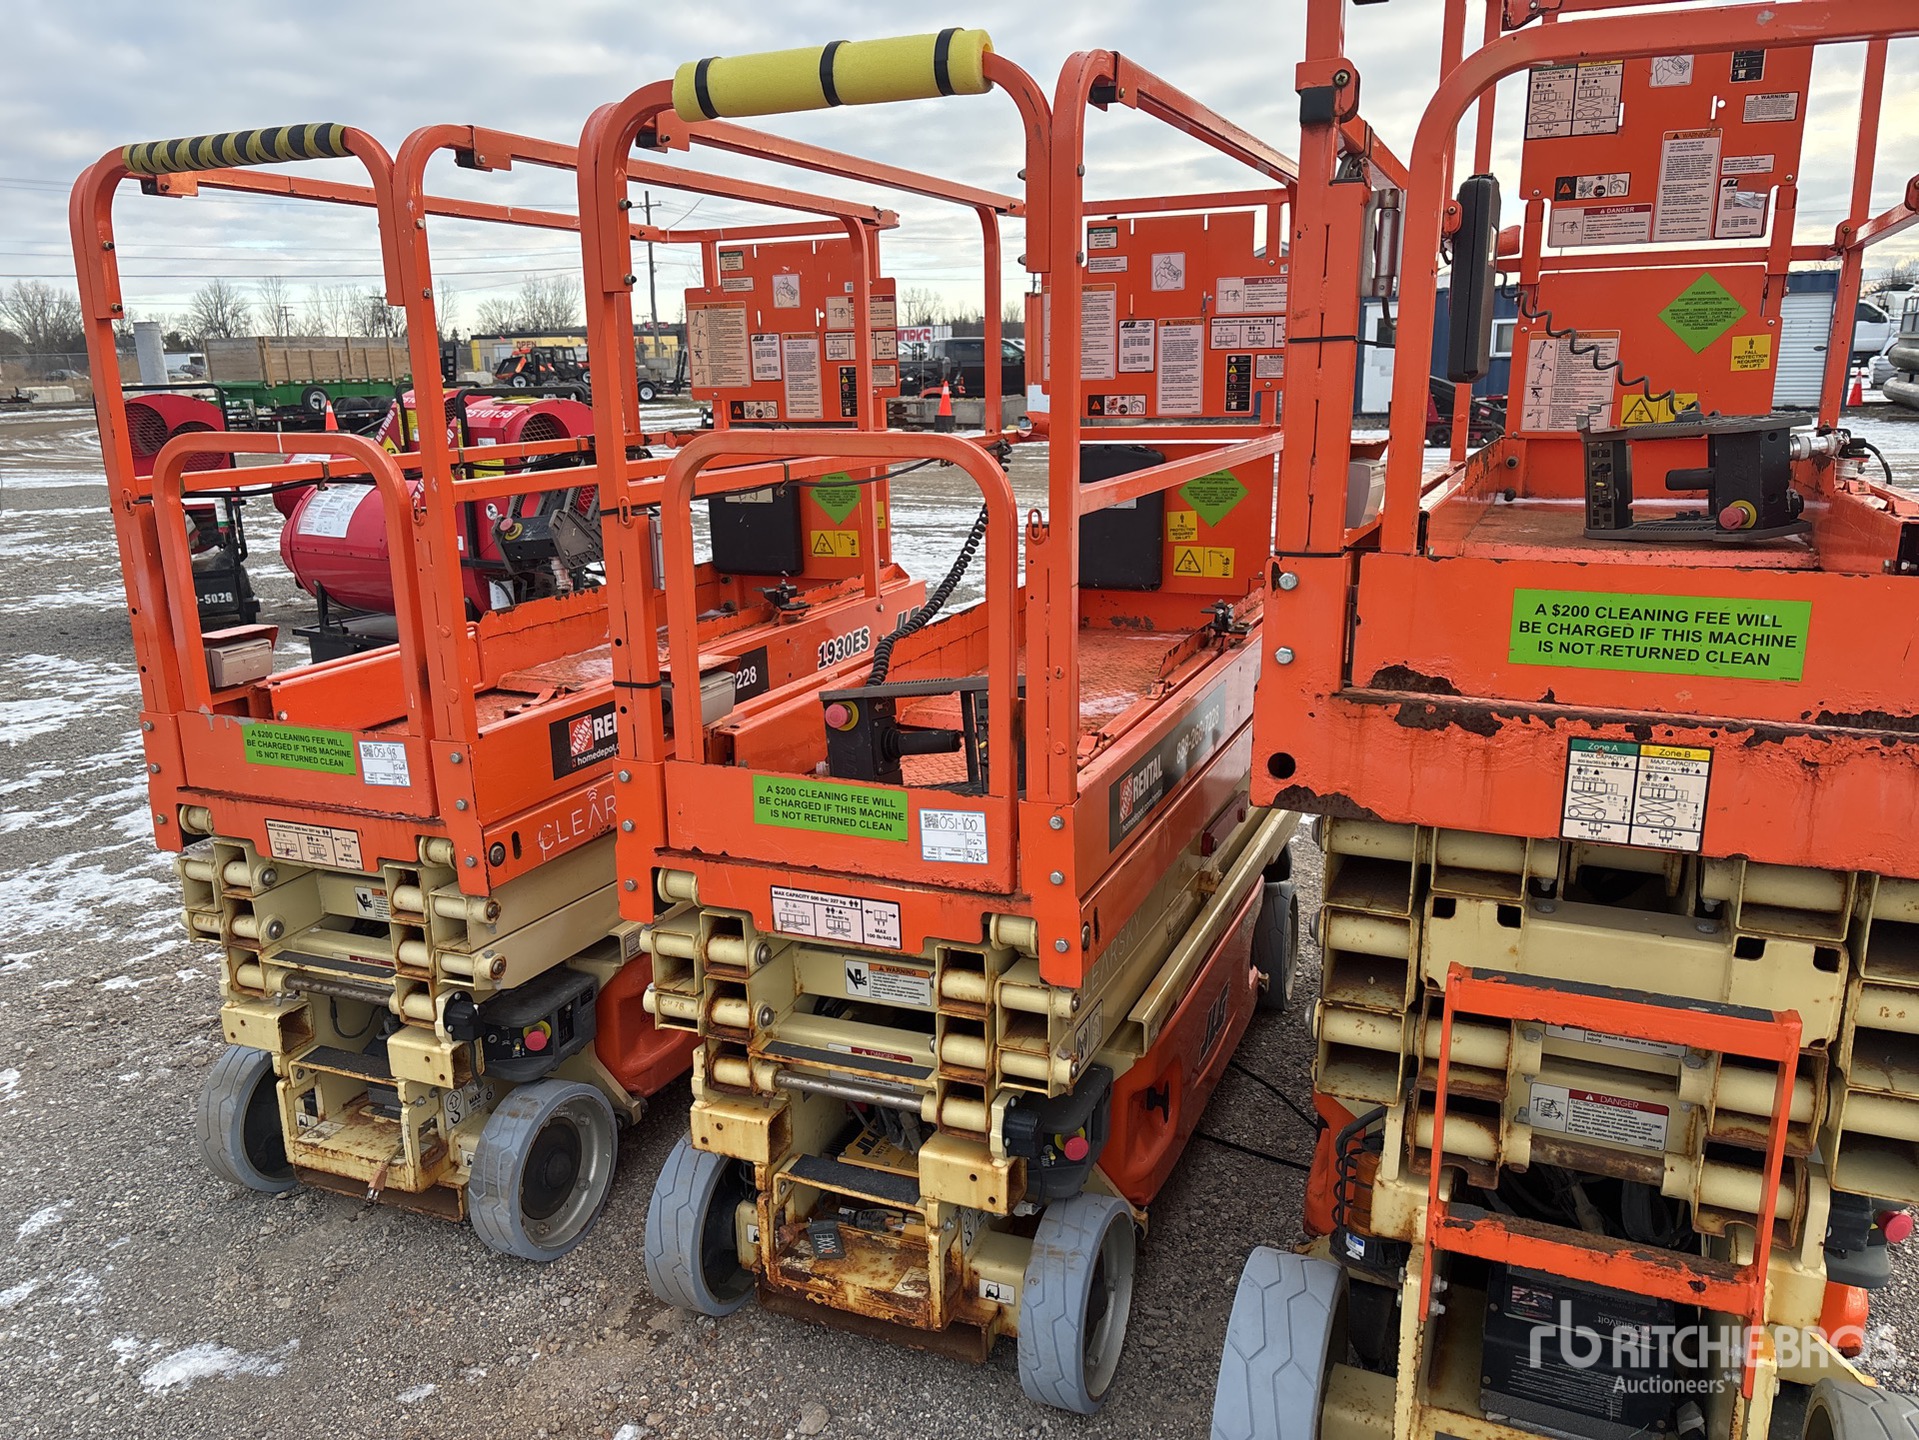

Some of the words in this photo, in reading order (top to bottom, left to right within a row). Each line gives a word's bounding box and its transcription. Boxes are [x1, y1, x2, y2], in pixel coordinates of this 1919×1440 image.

[516, 340, 537, 349] OPEN
[1535, 604, 1547, 616] A
[1552, 604, 1590, 618] $200
[1595, 607, 1689, 623] CLEANING
[1695, 612, 1731, 625] FEE
[1737, 614, 1782, 628] WILL
[1519, 621, 1542, 634] BE
[1547, 623, 1634, 639] CHARGED
[1640, 628, 1656, 640] IF
[1662, 629, 1702, 642] THIS
[1709, 632, 1797, 648] MACHINE
[818, 627, 869, 668] 1930ES
[1538, 641, 1553, 653] IS
[1559, 642, 1595, 655] NOT
[1600, 644, 1700, 661] RETURNED
[1706, 651, 1770, 666] CLEAN
[736, 666, 757, 689] 228
[258, 731, 273, 739] $200
[275, 732, 310, 743] CLEANING
[327, 738, 344, 747] WILL
[571, 716, 592, 754] HOME
[573, 723, 581, 737] THE
[258, 740, 292, 751] CHARGED
[302, 746, 317, 754] THIS
[320, 748, 351, 758] MACHINE
[581, 729, 593, 751] DEPOT
[1588, 743, 1610, 751] Zone
[256, 750, 263, 758] IS
[265, 751, 279, 759] NOT
[281, 754, 318, 764] RETURNED
[321, 758, 344, 767] CLEAN
[1659, 749, 1682, 757] Zone
[1133, 754, 1163, 803] RENTAL
[767, 785, 774, 793] A
[776, 786, 796, 796] $200
[799, 789, 848, 802] CLEANING
[851, 795, 869, 804] FEE
[872, 797, 896, 808] WILL
[759, 796, 771, 805] BE
[774, 798, 821, 811] CHARGED
[824, 804, 832, 812] IF
[835, 805, 857, 815] THIS
[860, 808, 904, 821] MACHINE
[782, 811, 801, 820] NOT
[804, 813, 857, 827] RETURNED
[860, 820, 893, 832] CLEAN
[786, 891, 809, 900] CAPACITY
[886, 967, 916, 976] WARNING
[1571, 1100, 1612, 1111] ELECTROCUTION
[1600, 1096, 1639, 1109] DANGER
